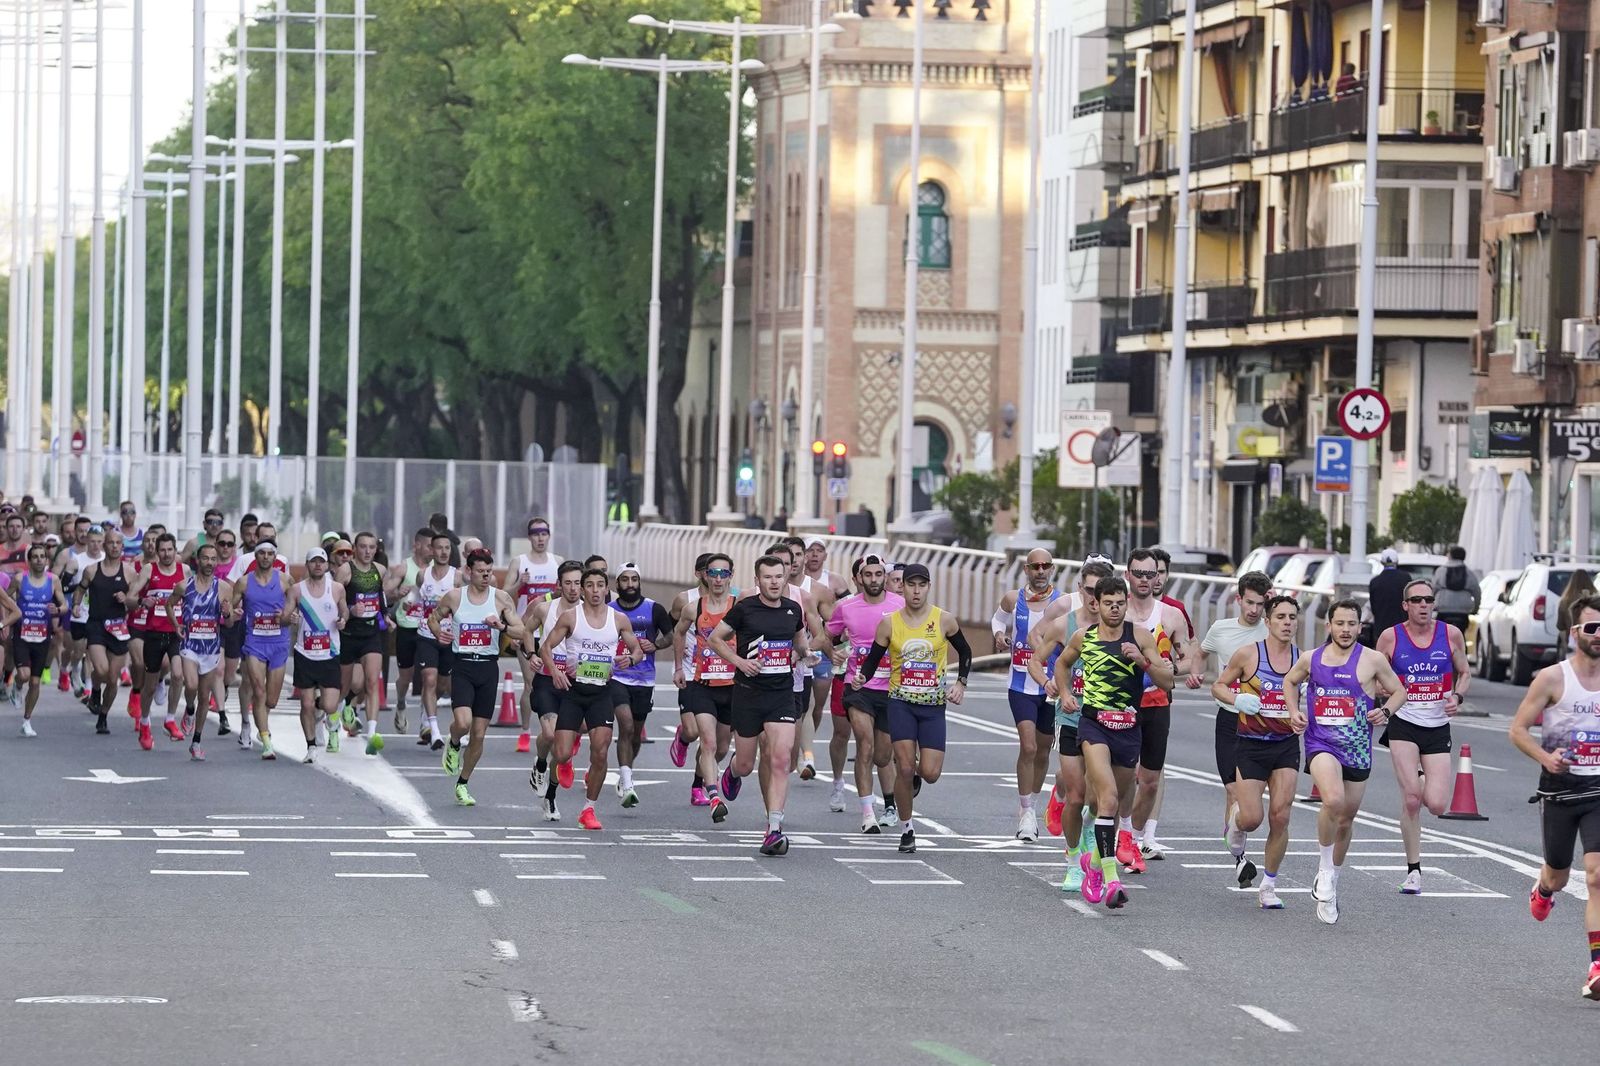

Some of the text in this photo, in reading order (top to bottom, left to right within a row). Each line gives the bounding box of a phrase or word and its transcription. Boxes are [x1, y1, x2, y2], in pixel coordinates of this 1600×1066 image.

[1350, 405, 1373, 420] 4,2
[1553, 422, 1600, 436] TINT
[1320, 441, 1343, 471] P
[708, 664, 728, 672] STEVE
[1407, 662, 1438, 674] COCAA
[902, 678, 935, 686] JCPULIDO
[1407, 692, 1441, 700] GREGORY
[1322, 707, 1344, 716] JONA
